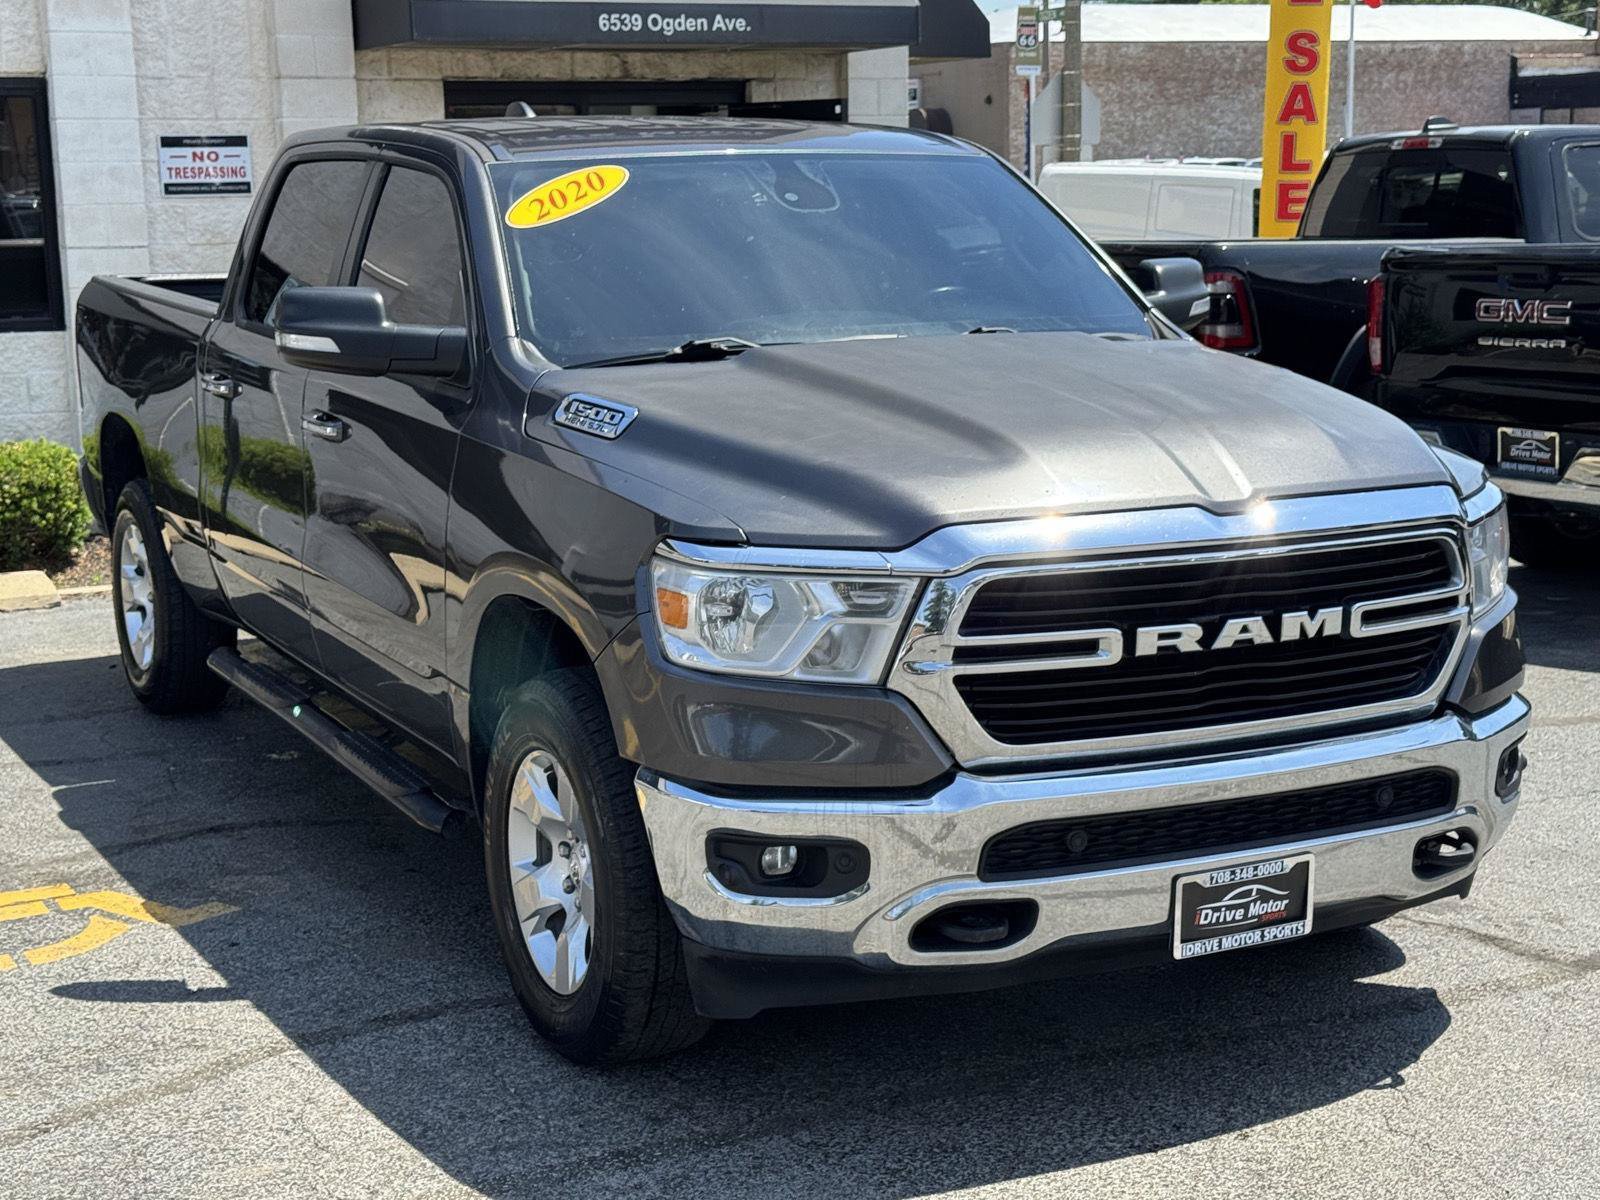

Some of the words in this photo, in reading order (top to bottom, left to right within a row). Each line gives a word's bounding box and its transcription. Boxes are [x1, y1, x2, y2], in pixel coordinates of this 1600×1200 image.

[598, 13, 643, 32] 6539
[647, 13, 708, 36] Ogden
[712, 14, 752, 32] Ave.
[1019, 35, 1036, 46] 66
[1275, 29, 1321, 223] SALE
[191, 151, 220, 163] NO
[166, 166, 247, 179] TRESPASSING
[528, 171, 605, 221] 2020
[1475, 298, 1573, 325] GMC
[569, 401, 623, 426] 1500
[1135, 606, 1343, 657] RAM
[1211, 861, 1282, 885] 708-348-0000
[1194, 907, 1245, 925] iDrive
[1248, 899, 1289, 918] Motor
[1261, 911, 1287, 922] SPORTS
[1221, 931, 1261, 949] MOTOR
[1263, 922, 1305, 941] SPORTS
